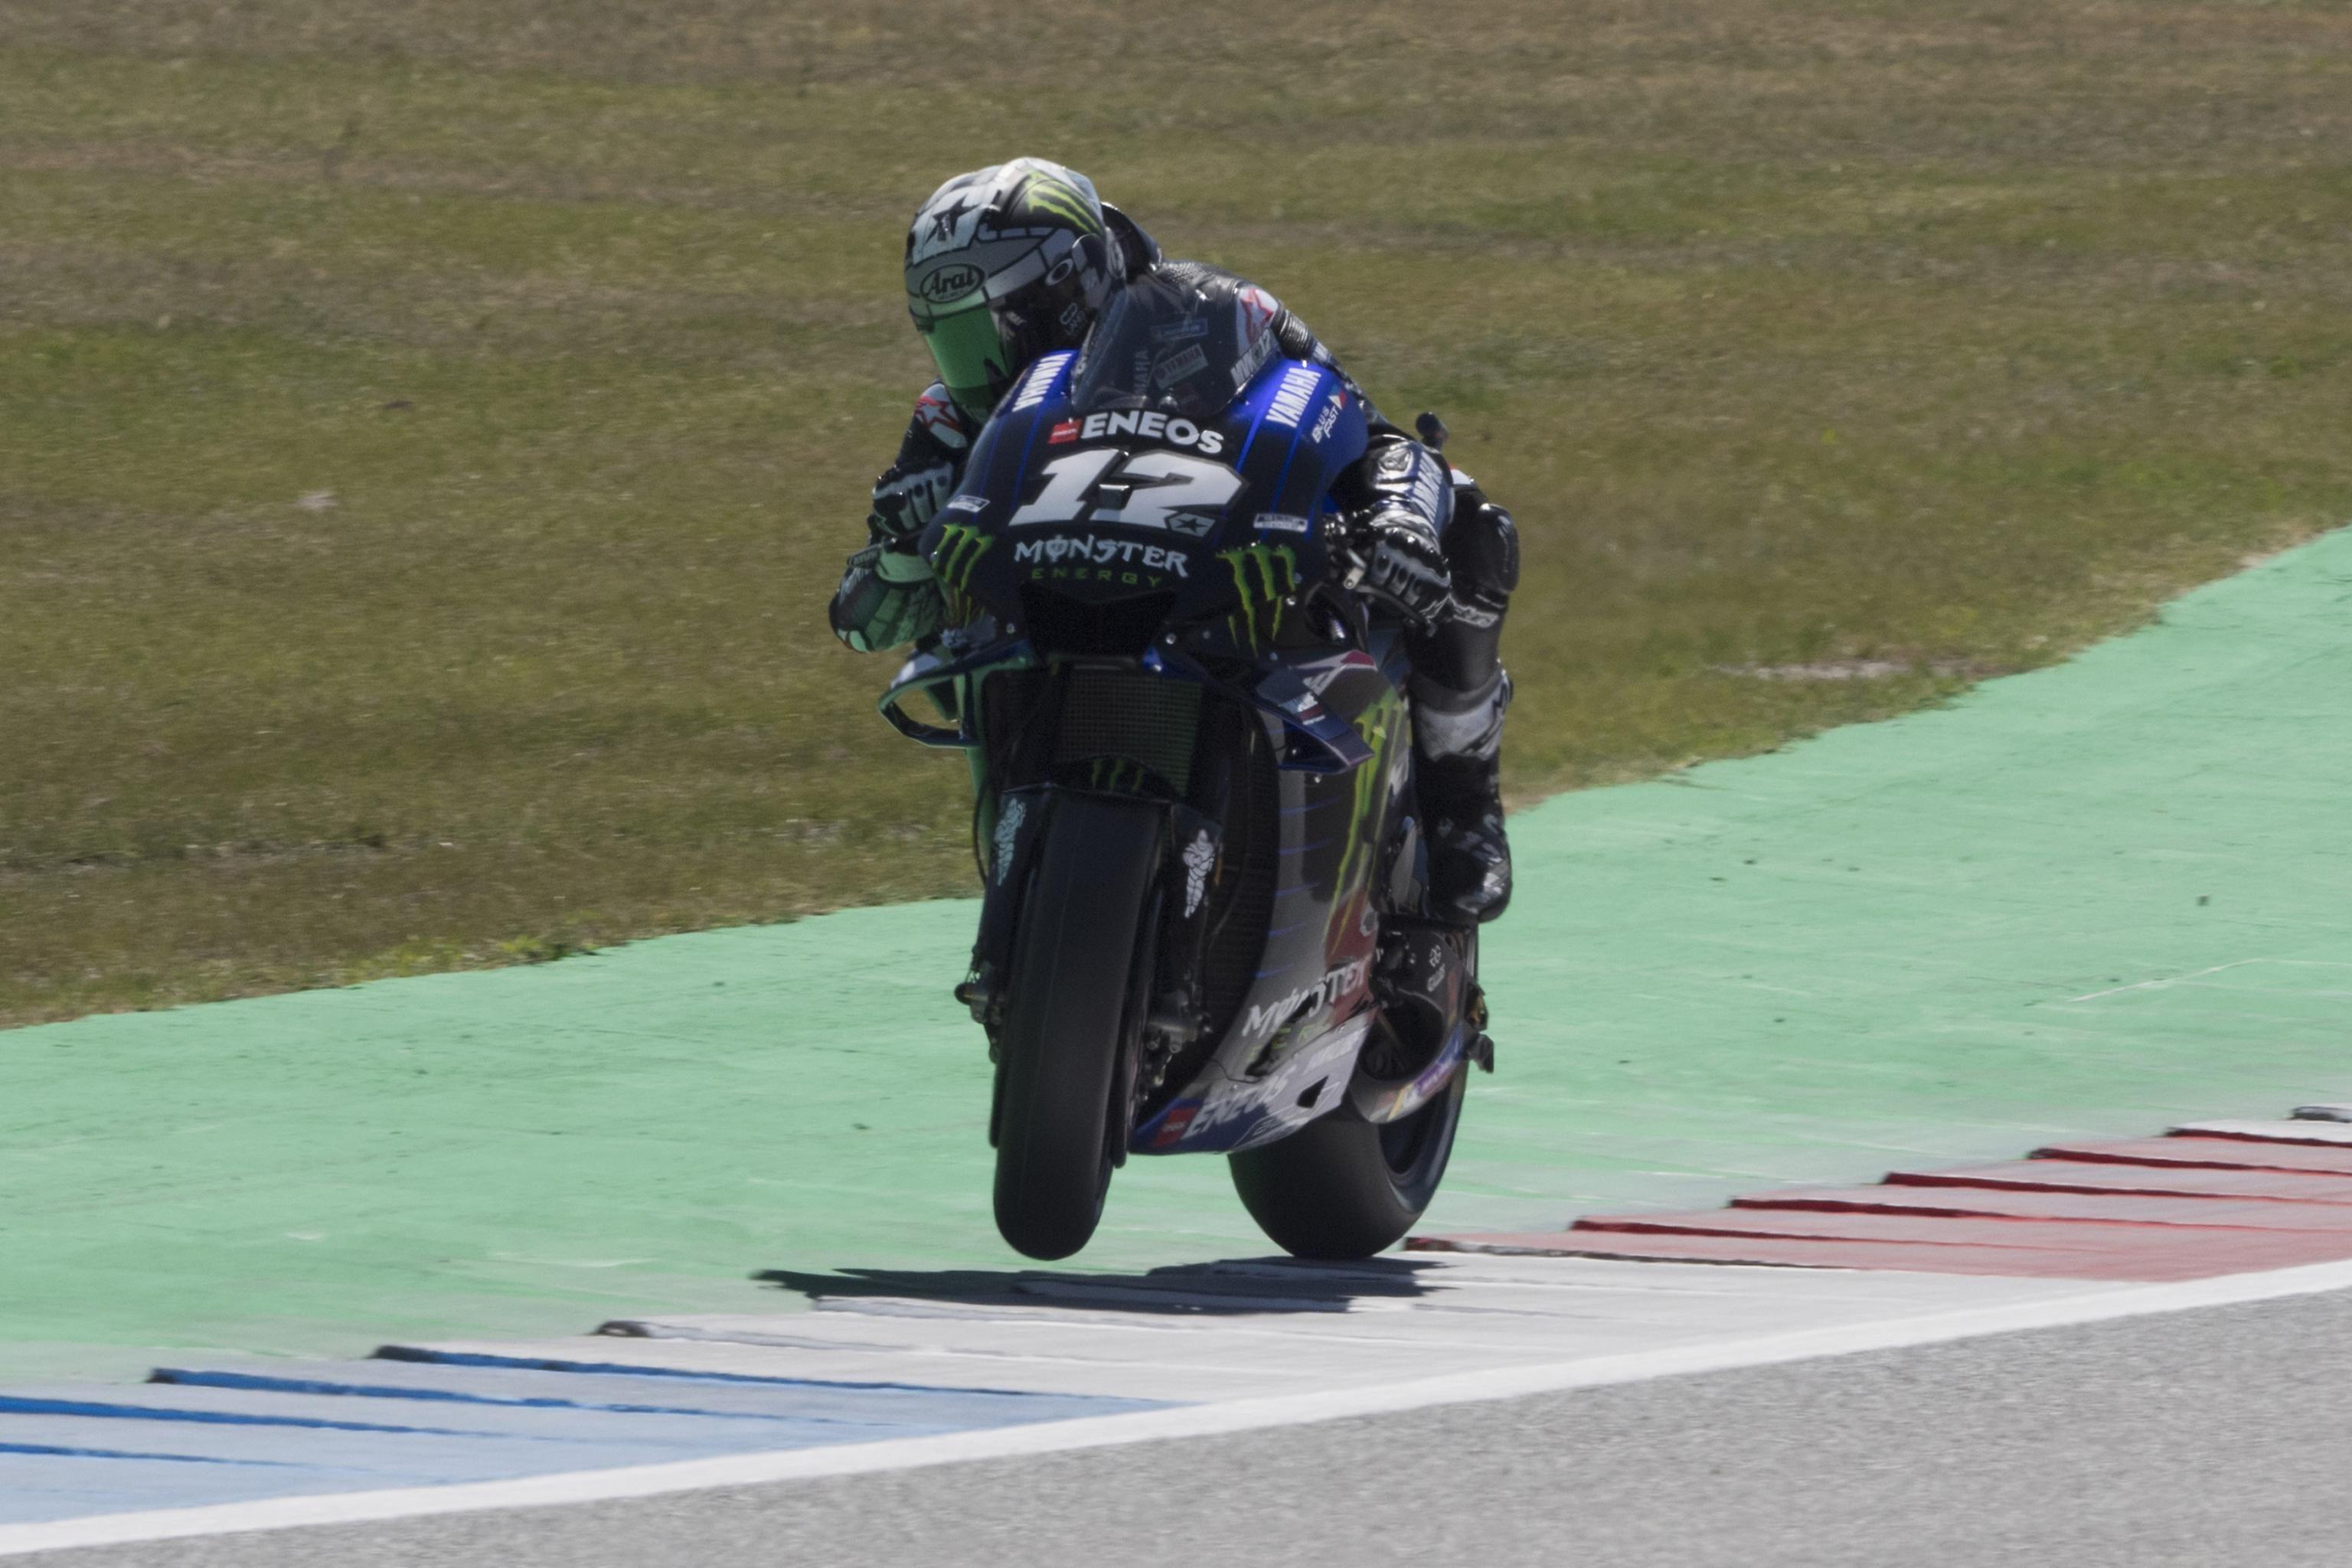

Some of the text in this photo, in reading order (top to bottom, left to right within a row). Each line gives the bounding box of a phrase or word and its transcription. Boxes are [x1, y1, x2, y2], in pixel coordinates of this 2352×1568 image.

[1012, 353, 1072, 412] YAMAHA
[1266, 368, 1321, 428] YAMAHA
[1080, 410, 1224, 453] ENEOS
[1323, 405, 1339, 439] FAST
[1010, 447, 1243, 530] 12
[1014, 534, 1188, 578] MONSTER
[1031, 567, 1163, 586] ENERGY
